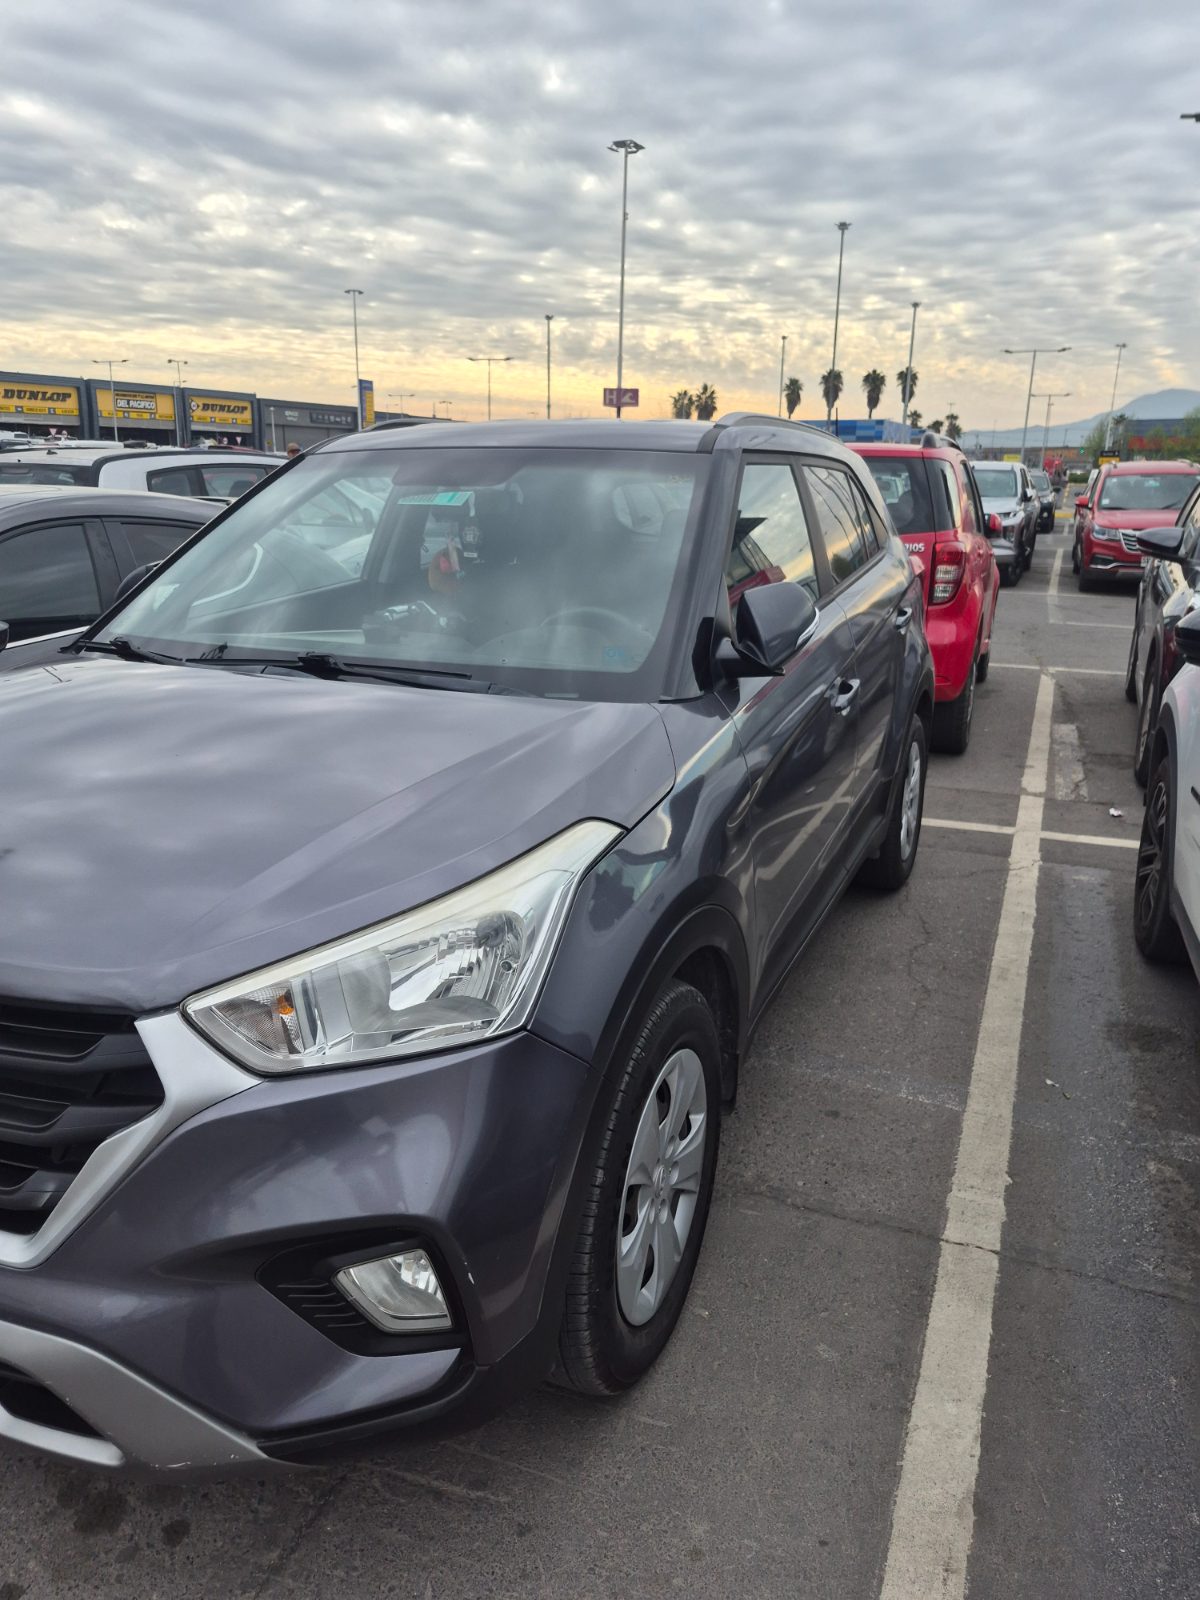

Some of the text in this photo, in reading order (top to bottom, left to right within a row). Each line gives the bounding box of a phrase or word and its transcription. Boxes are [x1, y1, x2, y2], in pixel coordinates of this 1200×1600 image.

[2, 388, 72, 402] DUNLOP
[116, 399, 155, 409] DEL PACIFICO
[201, 403, 248, 414] DUNLOP
